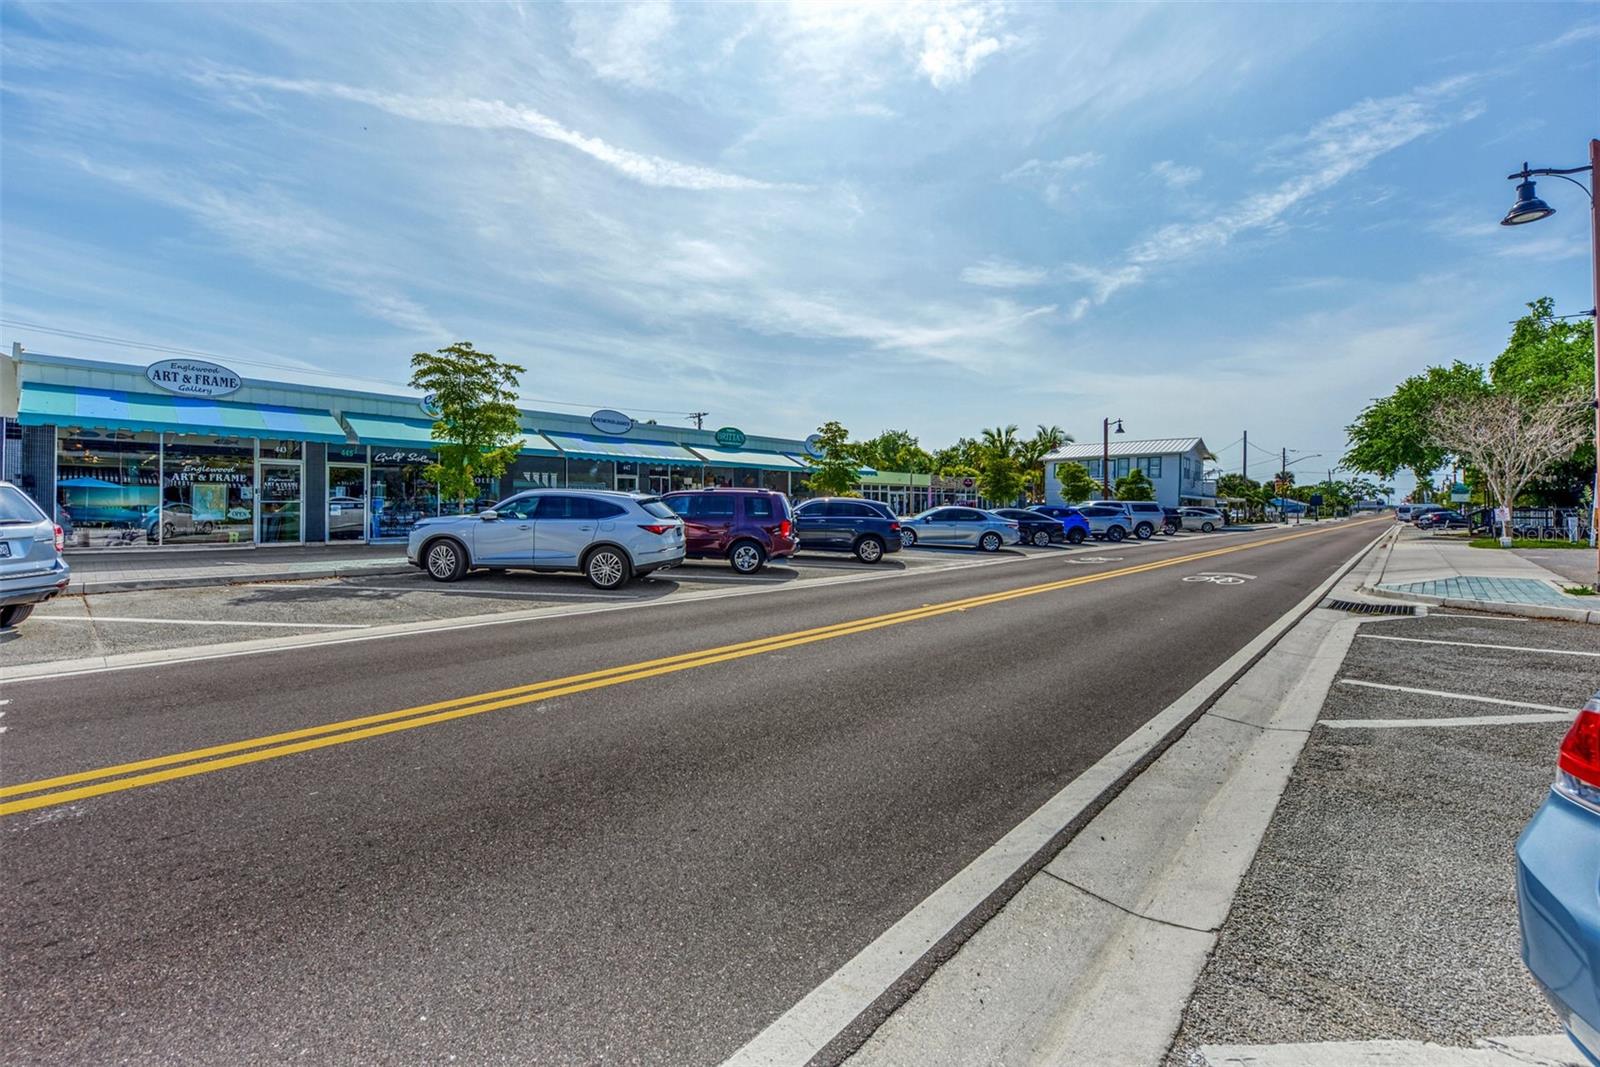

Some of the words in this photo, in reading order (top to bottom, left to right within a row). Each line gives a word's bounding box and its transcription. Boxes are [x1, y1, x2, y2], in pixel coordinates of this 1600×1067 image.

[170, 362, 220, 374] Englewood
[152, 370, 180, 383] ART
[182, 374, 192, 384] &
[195, 374, 239, 389] FRAME
[178, 384, 213, 395] Gallery
[374, 452, 406, 463] Gulf
[183, 464, 236, 474] Englewood
[171, 472, 195, 481] ART
[197, 473, 207, 482] &
[209, 473, 248, 482] FRAME
